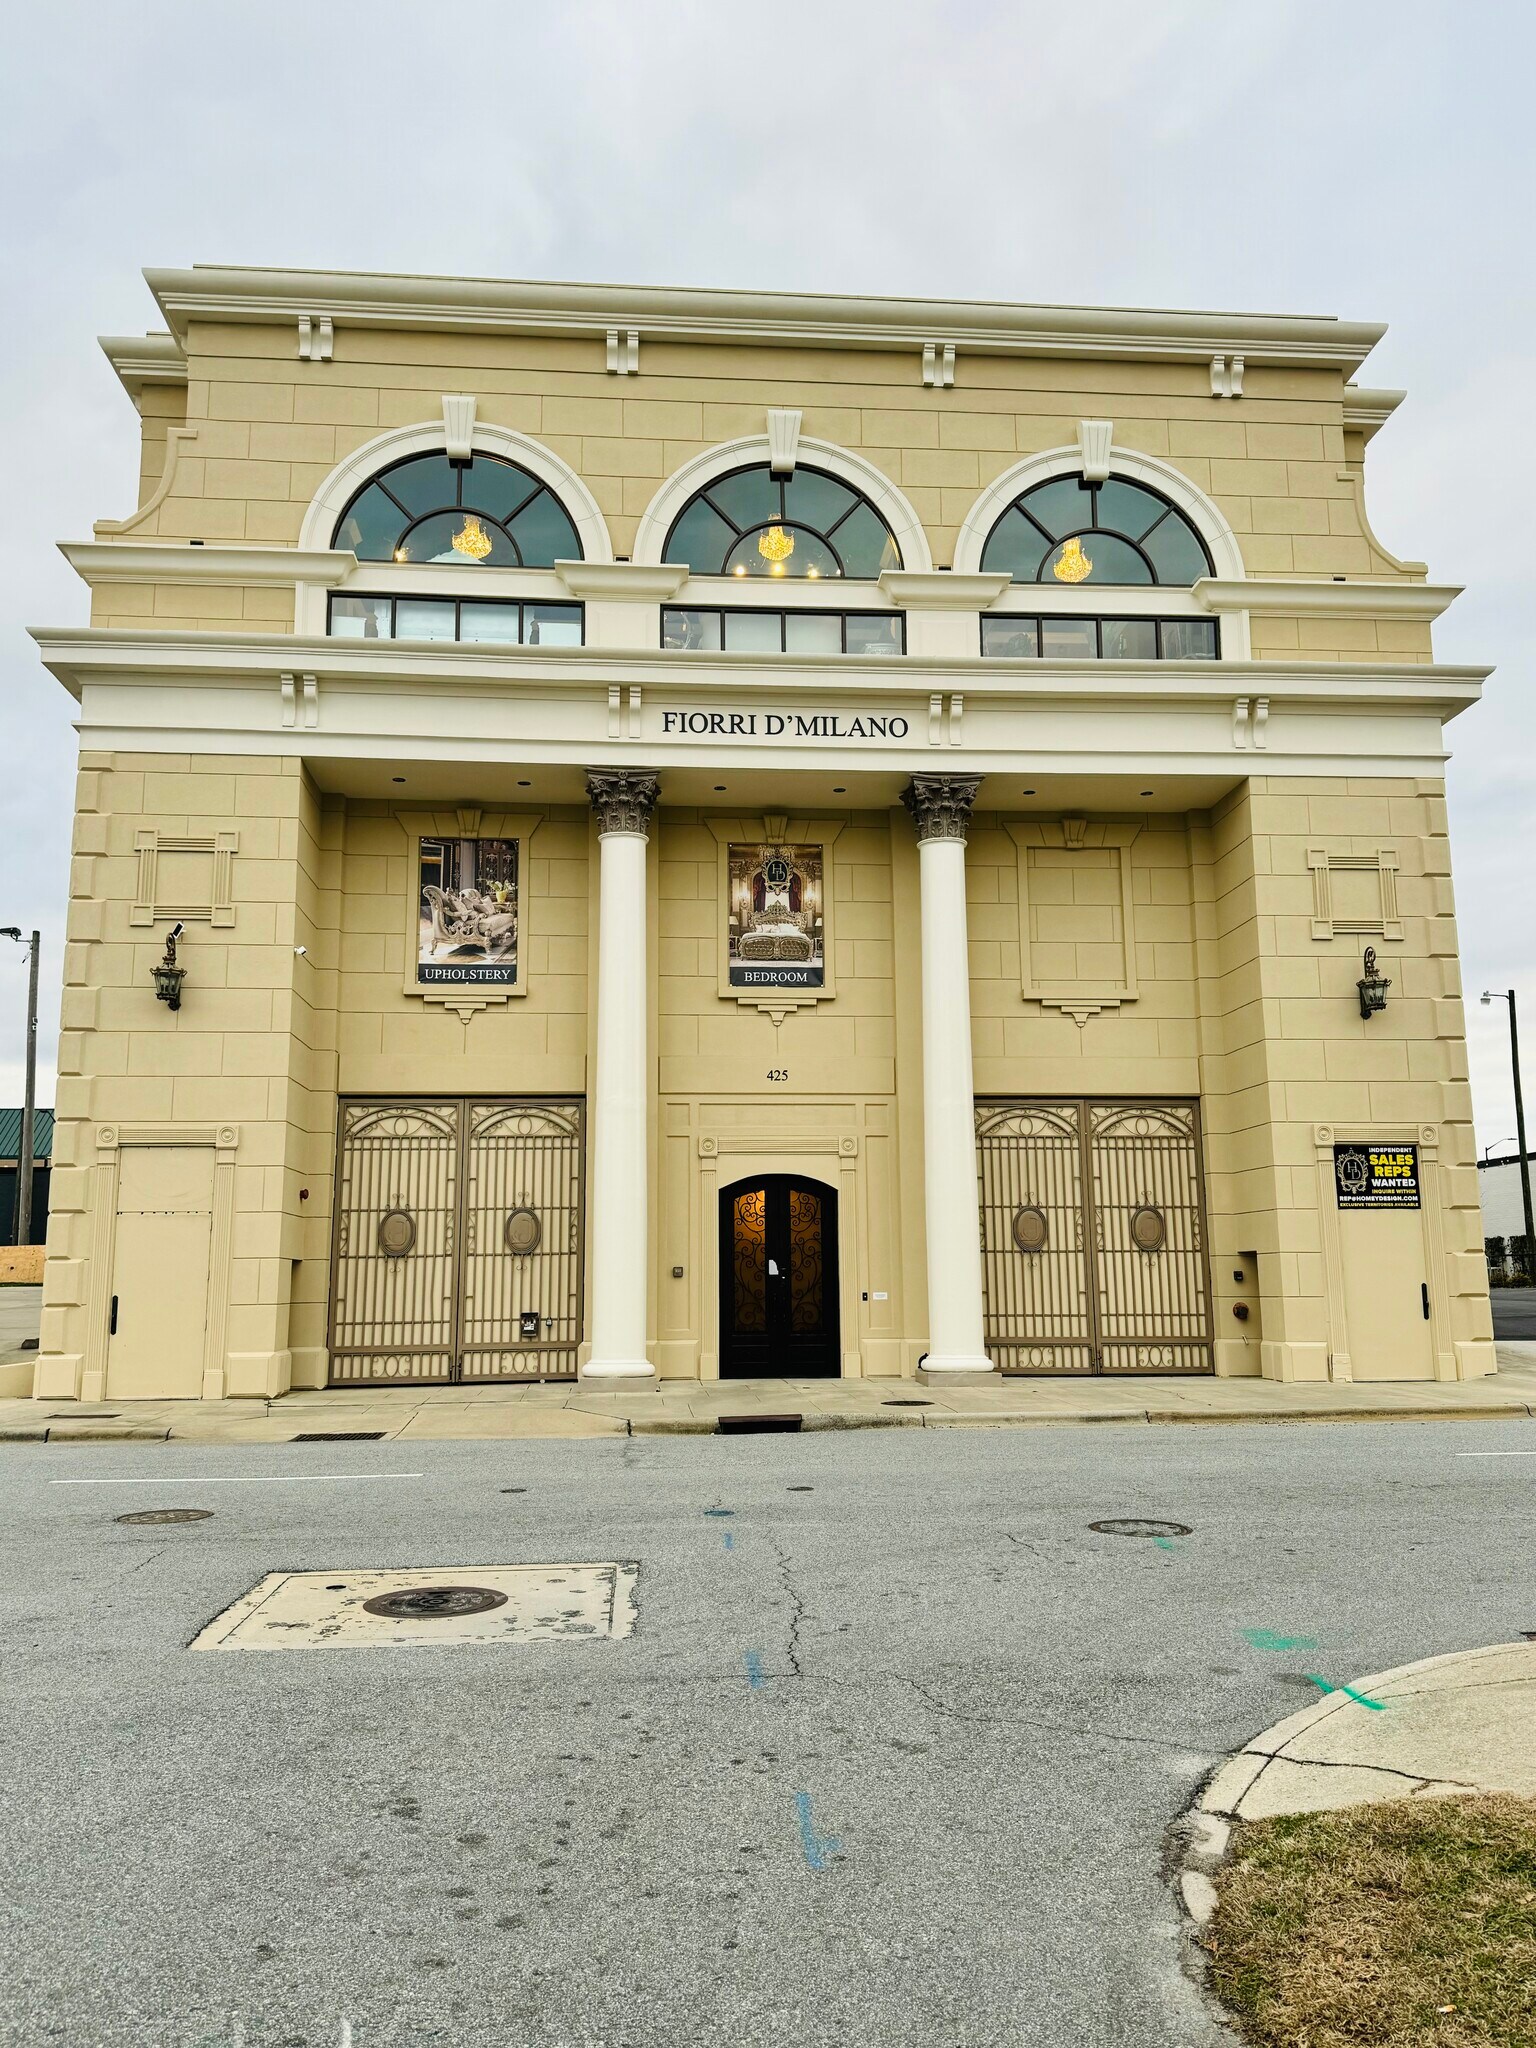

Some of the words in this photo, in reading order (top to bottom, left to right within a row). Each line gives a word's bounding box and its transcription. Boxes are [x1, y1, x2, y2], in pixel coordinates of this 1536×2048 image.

[662, 711, 757, 735] FIORRI
[424, 968, 511, 980] UPHOLSTERY
[744, 971, 808, 982] BEDROOM
[766, 1069, 788, 1081] 425
[1369, 1154, 1414, 1165] SALES
[1374, 1166, 1411, 1177] REPS
[1371, 1178, 1416, 1187] WANTED
